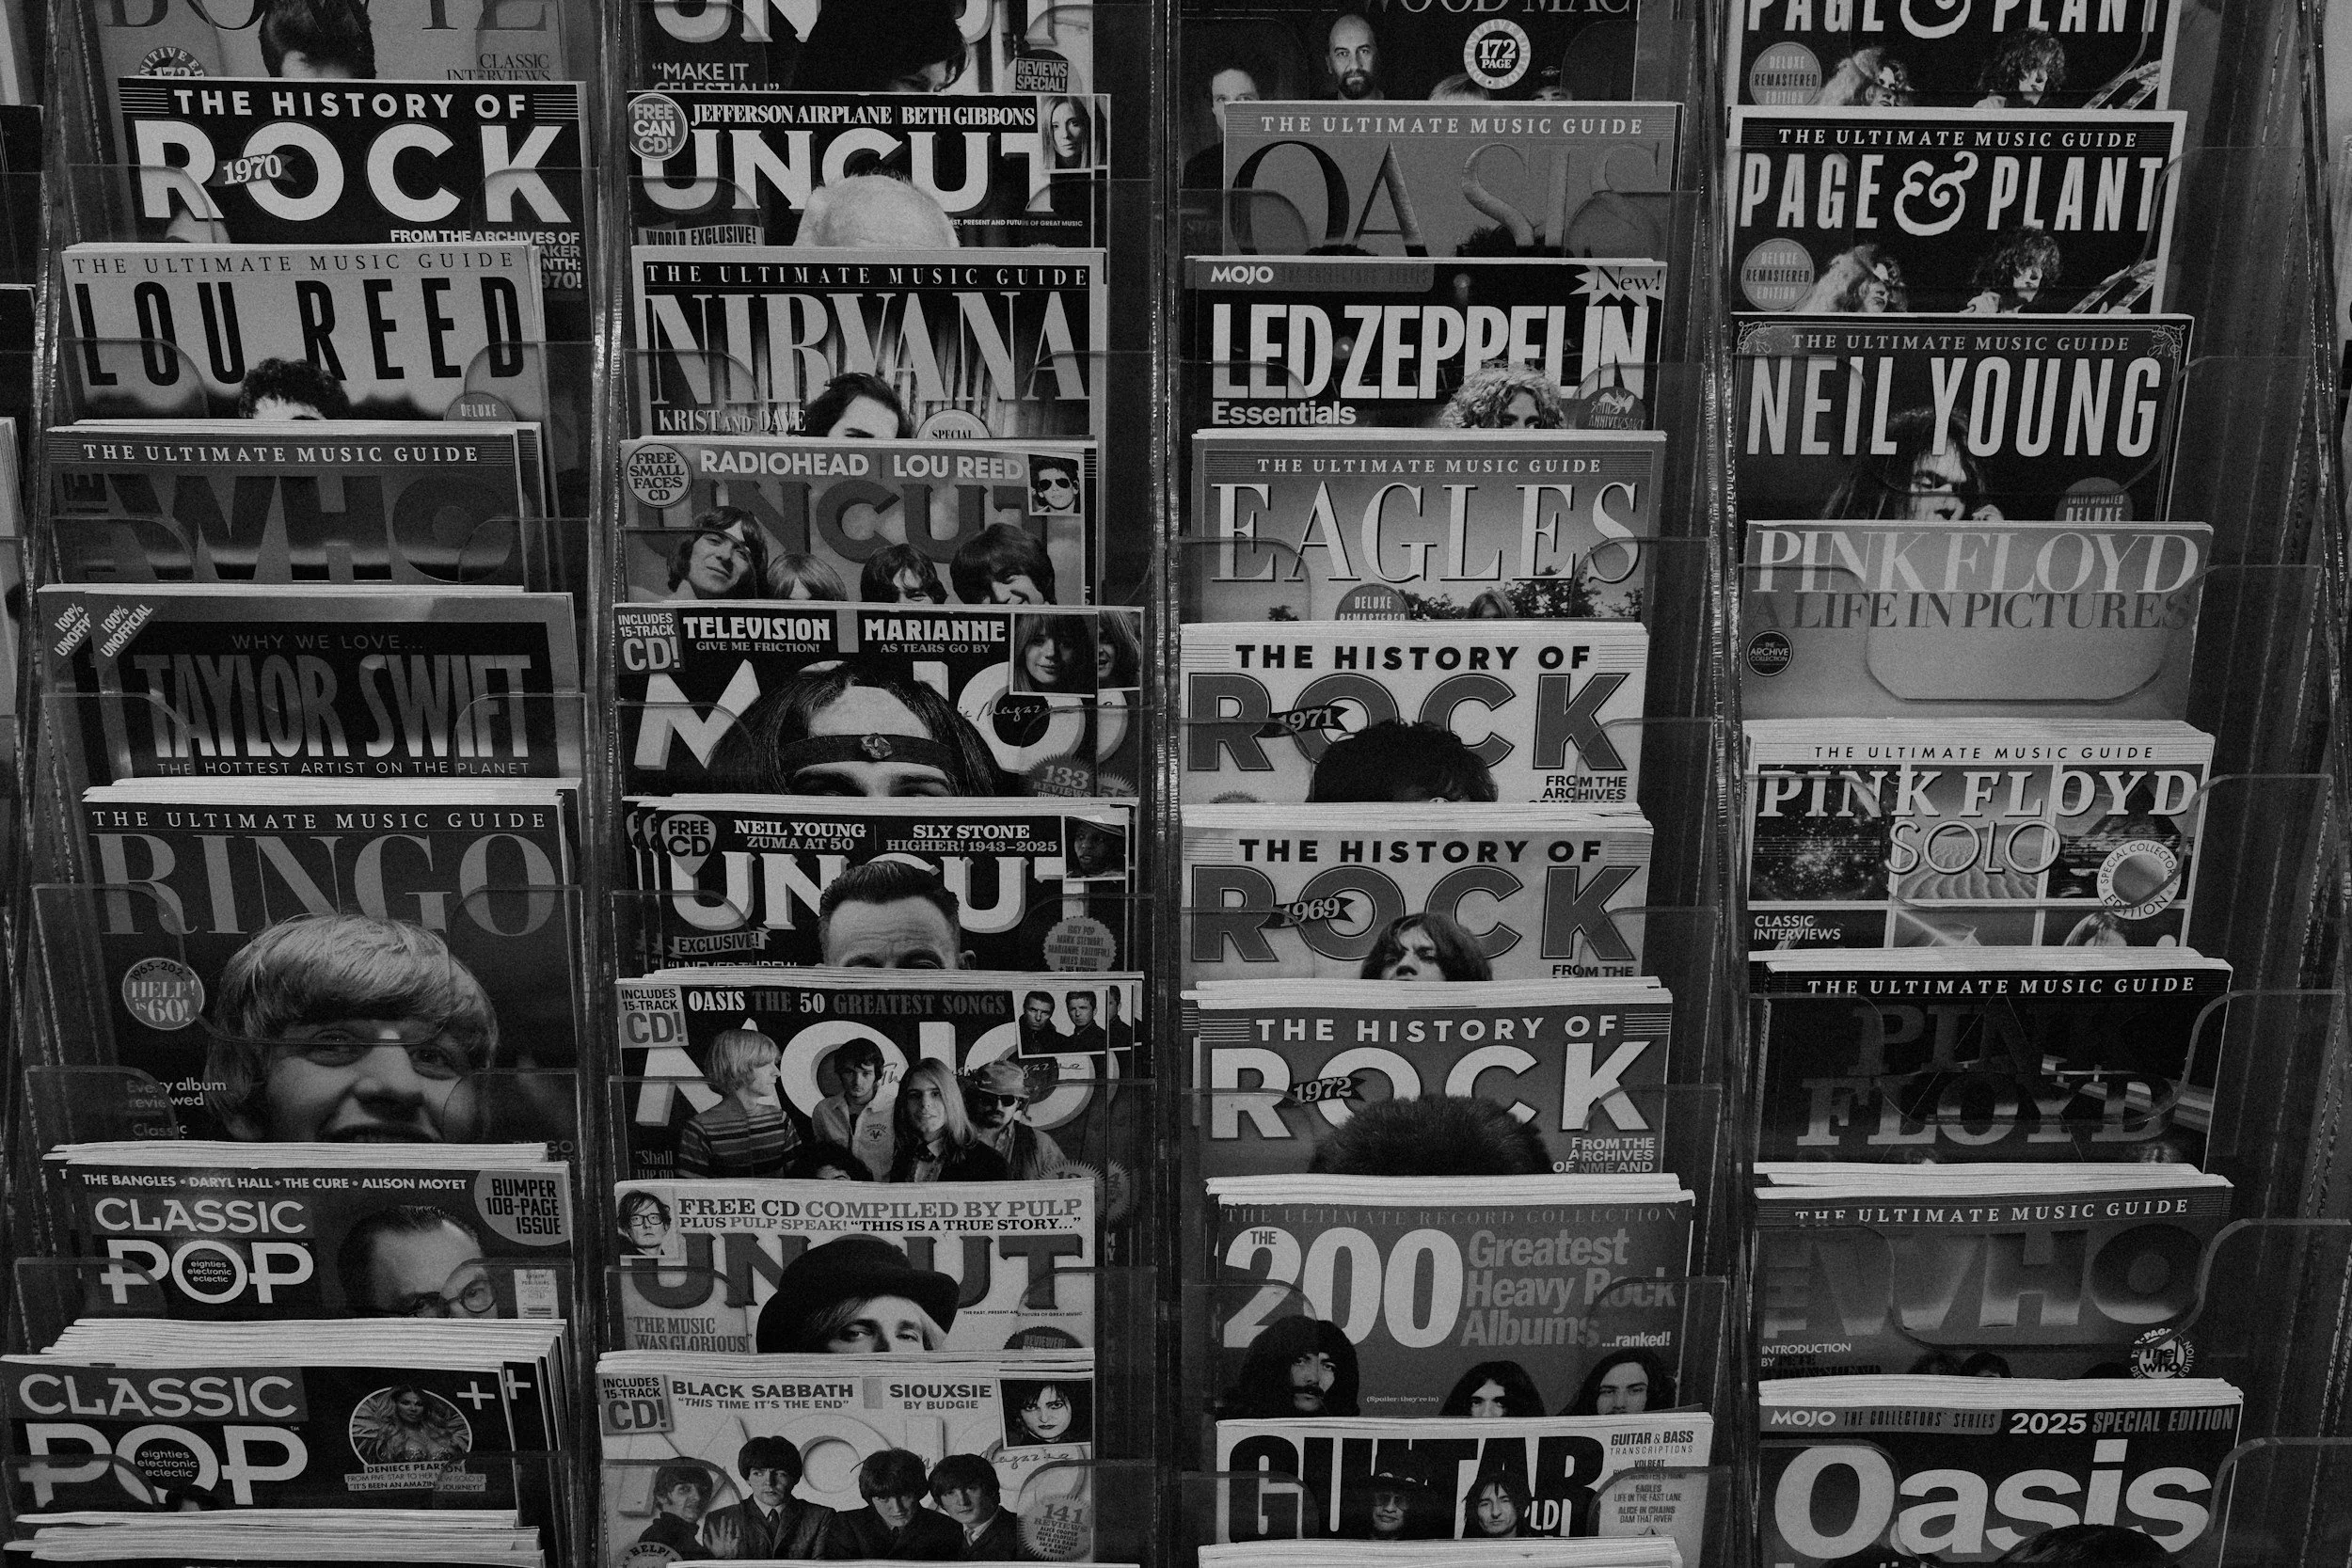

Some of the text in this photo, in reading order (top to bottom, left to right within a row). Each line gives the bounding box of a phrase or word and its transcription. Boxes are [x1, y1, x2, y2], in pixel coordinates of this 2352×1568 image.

[1479, 39, 1516, 59] 172
[1481, 58, 1512, 69] PAGE
[174, 89, 527, 119] THE HISTORY OF
[691, 103, 1034, 127] JEFFERSON AIRPLANE BETH GIBBONS
[1779, 129, 2137, 147] THE ULTIMATE MUSIC GUIDE
[134, 119, 572, 223] ROCK
[222, 153, 282, 186] 1970
[1740, 150, 2163, 236] PAGE & PLANT
[72, 252, 514, 275] THE ULTIMATE MUSIC GUIDE
[647, 264, 1088, 285] THE ULTIMATE MUSIC GUIDE
[1745, 270, 1809, 283] REMASTERED
[73, 277, 526, 387] LOU REED
[1792, 334, 2130, 352] THE ULTIMATE MUSIC GUIDE
[644, 292, 1089, 405] NIRVANA
[1212, 303, 1649, 400] LED ZEPPELIN
[1212, 401, 1357, 424] Essentials
[1746, 356, 2161, 458] NEIL YOUNG
[84, 444, 480, 463] THE ULTIMATE MUSIC GUIDE
[635, 452, 677, 466] FREE
[700, 450, 1024, 480] RADIOHEAD LOU REED
[629, 466, 684, 478] SMALL
[1257, 458, 1601, 473] THE ULTIMATE MUSIC GUIDE
[633, 478, 683, 488] FACES
[648, 489, 670, 500] CD
[1211, 480, 1641, 583] EAGLES
[1753, 530, 2198, 594] PINK FLOYD
[618, 612, 674, 626] INCLUDES
[683, 616, 1005, 641] TELEVISION MARIANNE
[619, 624, 675, 638] 15-TRACK
[622, 636, 681, 672] CD!
[1235, 645, 1591, 670] THE HISTORY OF
[134, 655, 532, 758] TAYLOR SWIFT
[1186, 673, 1629, 771] ROCK
[1279, 708, 1334, 730] 1971
[1815, 747, 2154, 760] THE ULTIMATE MUSIC GUIDE
[158, 761, 529, 775] THE HOTTEST ARTIST ON THE PLANET
[1758, 769, 2198, 817] PINK FLOYD
[93, 811, 546, 829] THE ULTIMATE MUSIC GUIDE
[734, 820, 1030, 839] NEIL YOUNG SLY STONE
[1239, 839, 1601, 863] THE HISTORY OF
[1884, 820, 2062, 876] SOLO
[88, 832, 556, 937] RINGO
[1190, 864, 1641, 961] ROCK
[1280, 899, 1341, 927] 1969
[1755, 915, 1814, 927] CLASSIC
[1754, 927, 1841, 941] INTERVIEWS
[688, 990, 1006, 1015] OASIS THE 50 GREATEST SONGS
[1256, 1015, 1616, 1042] THE HISTORY OF
[1211, 1040, 1652, 1140] ROCK
[1294, 1077, 1352, 1102] 1972
[83, 1174, 467, 1192] THE BANGLES DARYL HALL THE CURE ALISON MOYET
[492, 1179, 557, 1198] BUMPER
[95, 1196, 307, 1233] CLASSIC
[485, 1196, 559, 1216] 108-PAGE
[679, 1197, 1082, 1219] FREE CD COMPILED BY PULP
[516, 1217, 562, 1236] ISSUE
[101, 1240, 314, 1304] POP
[1224, 1226, 1629, 1349] 200 Greatest
[1761, 1342, 1851, 1355] INTRODUCTION
[19, 1373, 298, 1417] CLASSIC
[672, 1381, 992, 1400] BLACK SABBATH SIOUXSIE
[1771, 1411, 1836, 1427] MOJO
[2010, 1408, 2234, 1434] 2025 SPECIAL EDITION
[1611, 1431, 1693, 1447] GUITAR & BASS
[19, 1422, 309, 1508] POP
[136, 1459, 198, 1469] electronic
[141, 1449, 190, 1461] eighties
[146, 1469, 194, 1479] eclectic
[1666, 1493, 1681, 1501] LANE
[1774, 1439, 2213, 1559] Oasis
